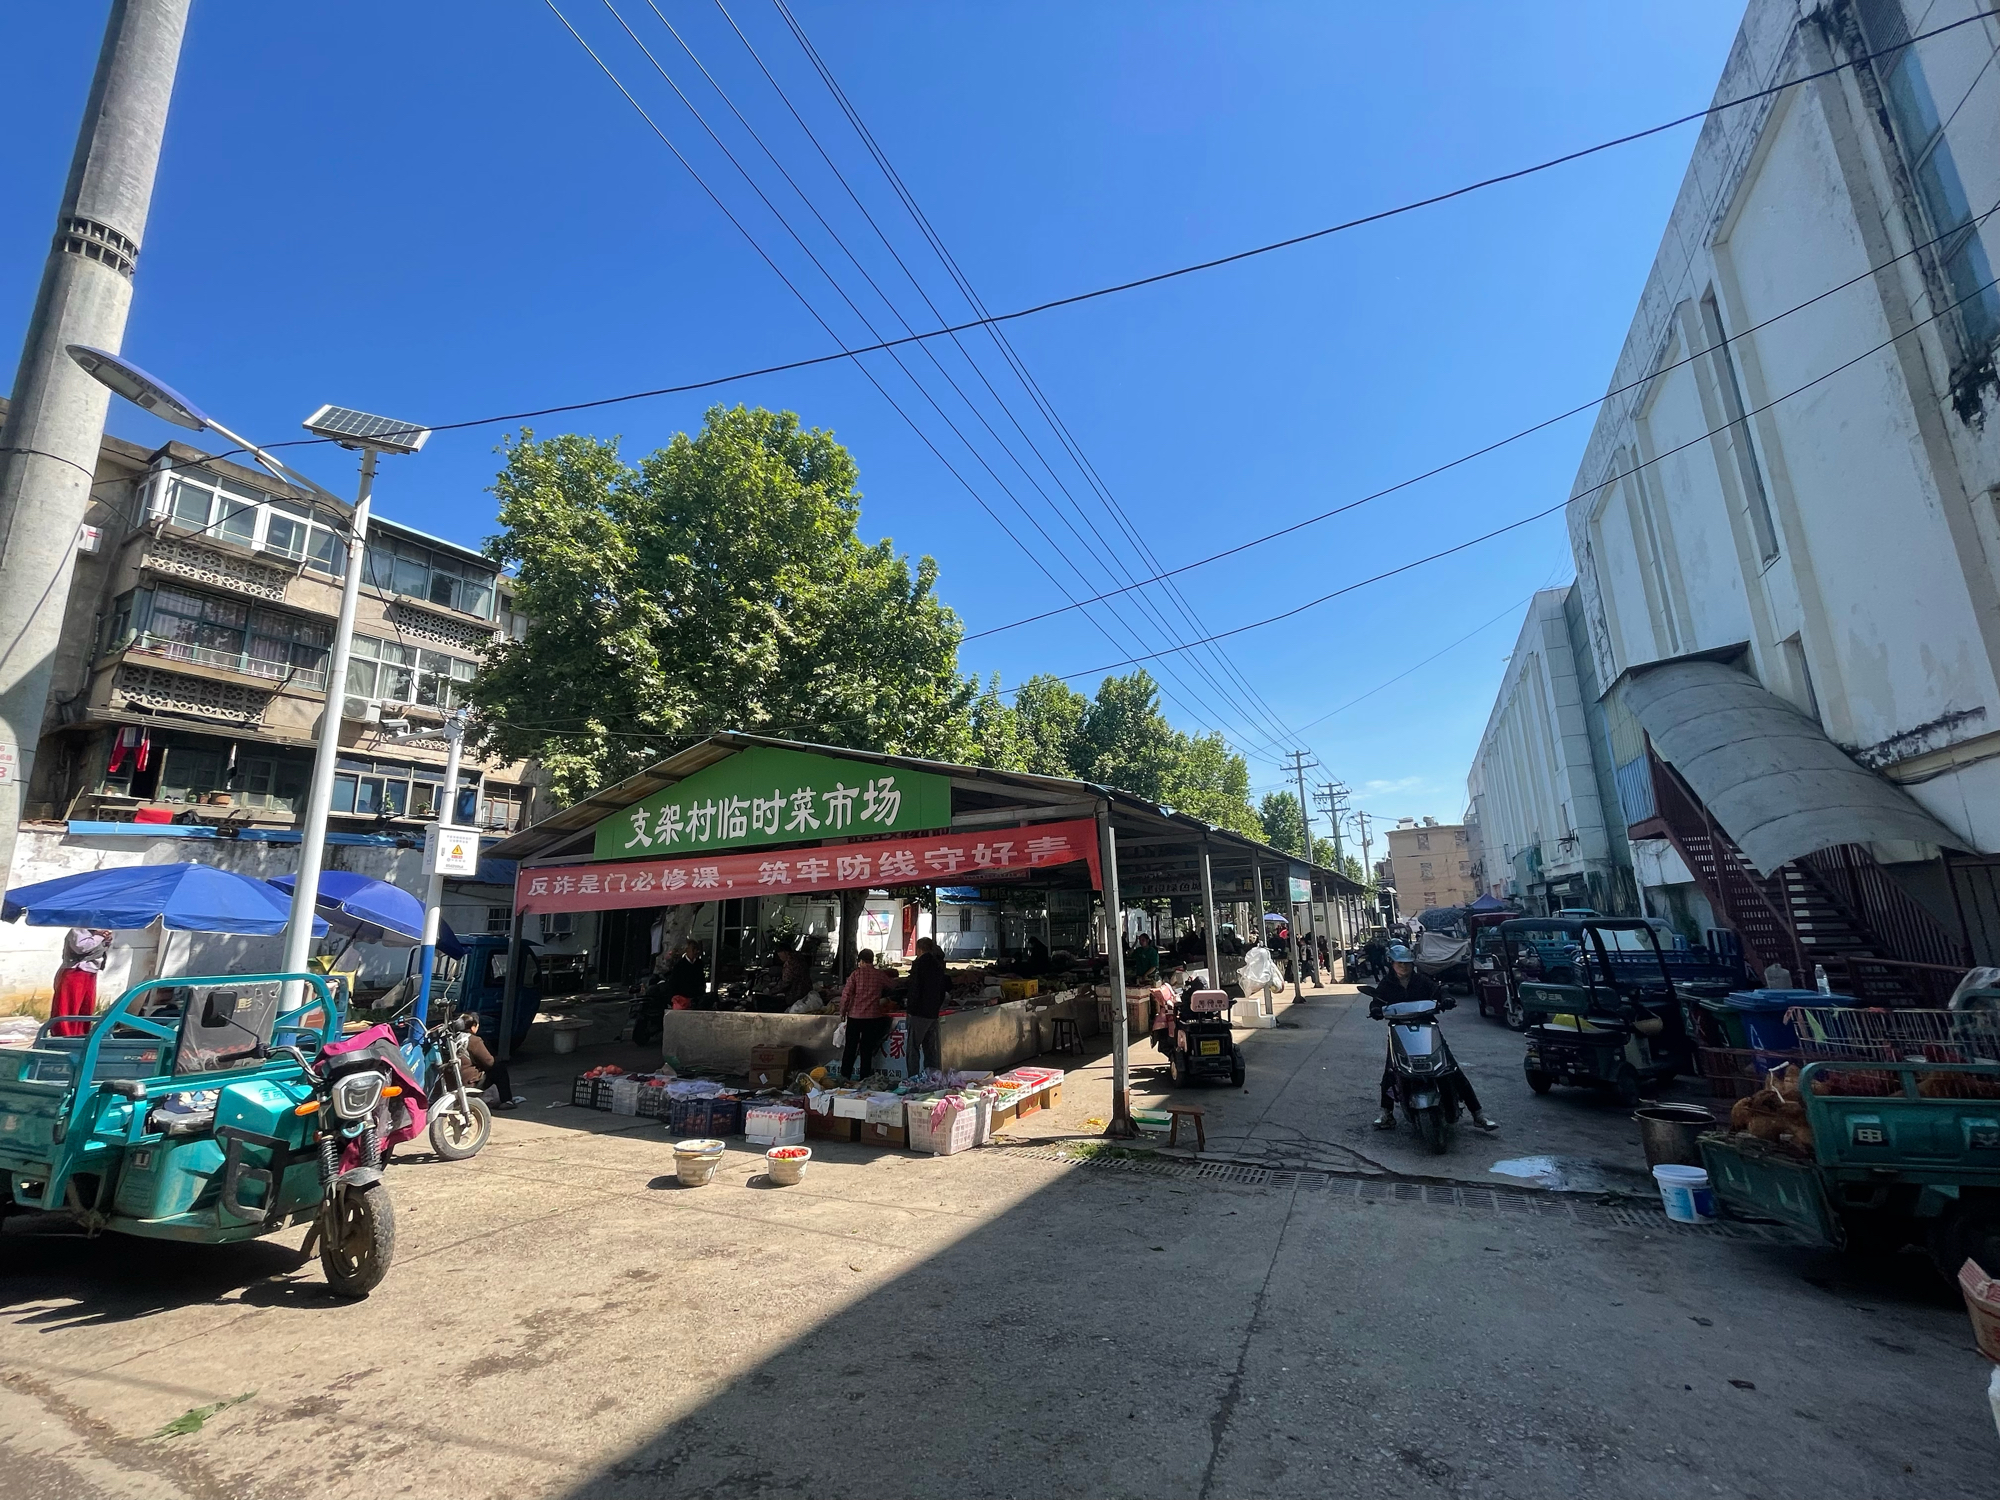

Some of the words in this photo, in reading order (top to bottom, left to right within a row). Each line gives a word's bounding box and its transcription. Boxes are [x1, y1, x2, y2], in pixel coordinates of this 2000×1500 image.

[625, 776, 901, 849] 支架村临时菜市场
